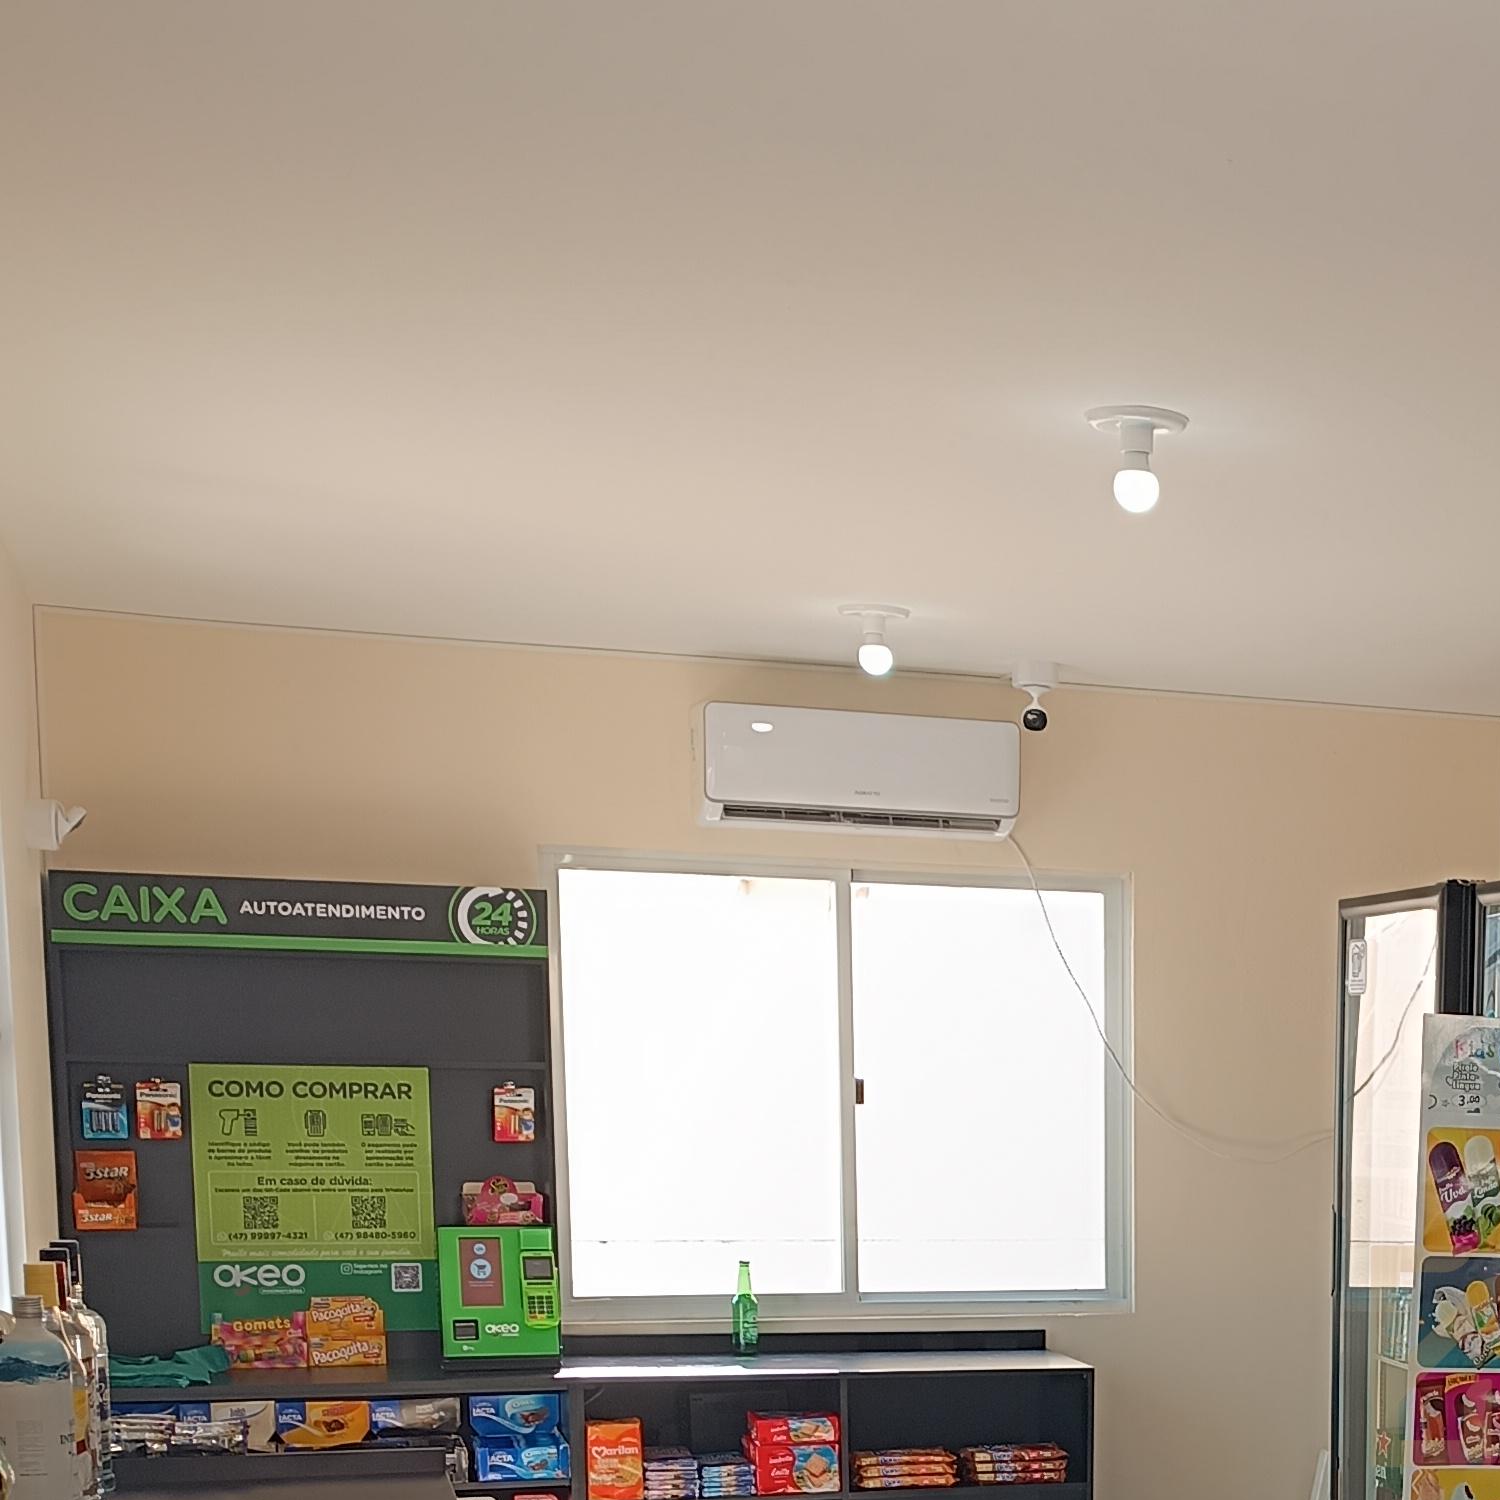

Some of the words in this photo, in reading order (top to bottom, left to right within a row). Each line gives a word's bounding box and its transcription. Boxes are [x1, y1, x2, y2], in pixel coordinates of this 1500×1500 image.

[63, 883, 228, 925] CAIXA
[239, 901, 425, 921] AUTOATENDIMENTO
[472, 901, 512, 927] 24
[475, 925, 510, 936] HORAS
[208, 1080, 284, 1099] COMO
[292, 1081, 412, 1100] COMPRAR
[258, 1177, 276, 1186] Em
[280, 1178, 306, 1186] caso
[310, 1176, 326, 1186] de
[329, 1175, 372, 1186] dúvida:
[1441, 1188, 1466, 1203] Uva
[228, 1232, 248, 1241] (47)
[334, 1232, 354, 1241] (47)
[233, 1316, 291, 1332] Gomets
[372, 1411, 396, 1422] LACTA
[472, 1406, 496, 1416] LACTA
[279, 1413, 302, 1424] LACTA
[488, 1454, 514, 1463] LACTA
